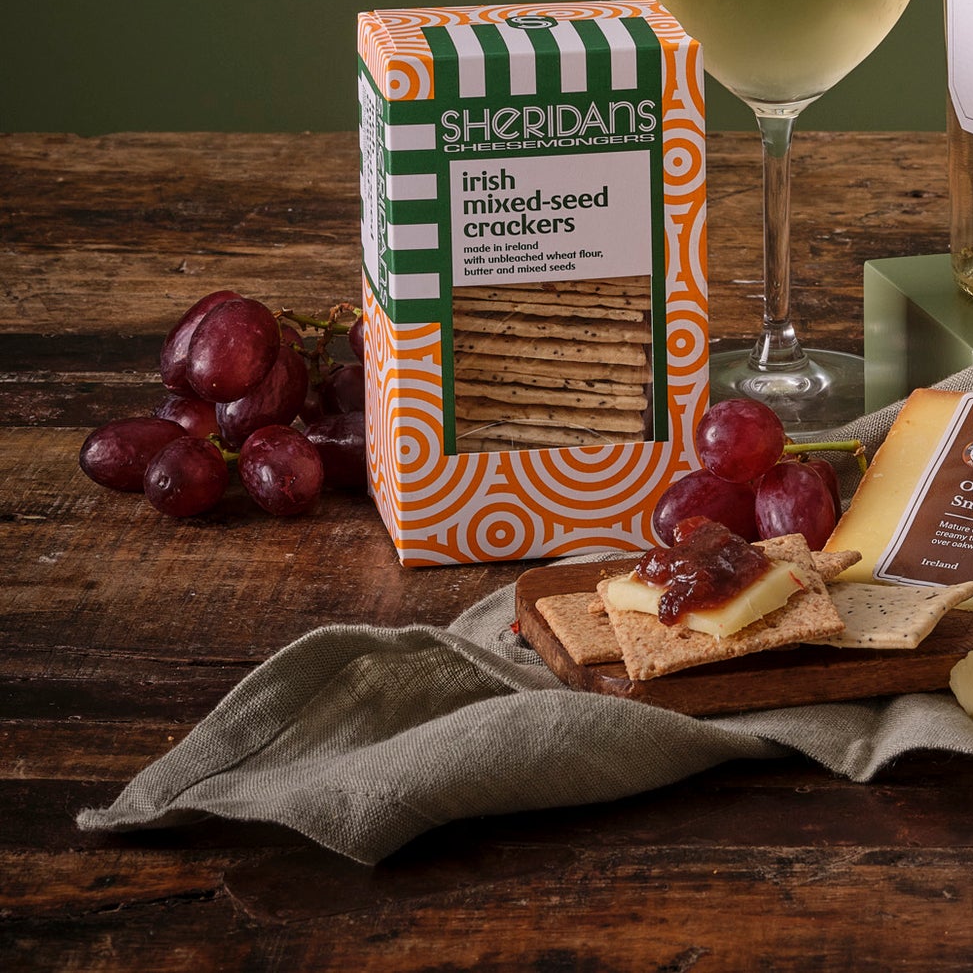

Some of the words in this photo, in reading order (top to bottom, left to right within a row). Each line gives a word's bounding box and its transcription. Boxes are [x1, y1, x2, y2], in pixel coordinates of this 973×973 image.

[443, 133, 655, 153] CHEESEMONGERS
[462, 168, 516, 192] irish
[463, 185, 609, 215] mixed-seed
[463, 214, 576, 238] crackers
[463, 244, 491, 254] made
[493, 243, 503, 252] in
[505, 241, 539, 252] ireland
[464, 255, 486, 265] with
[488, 252, 544, 264] unbleached
[546, 250, 577, 261] wheat
[579, 249, 604, 259] flour,
[464, 266, 494, 276] butter
[496, 265, 515, 275] and
[517, 263, 547, 274] mixed
[550, 262, 576, 272] seeds
[939, 520, 971, 533] Mature
[931, 538, 950, 546] over
[935, 530, 967, 541] creamy
[921, 558, 959, 570] Ireland
